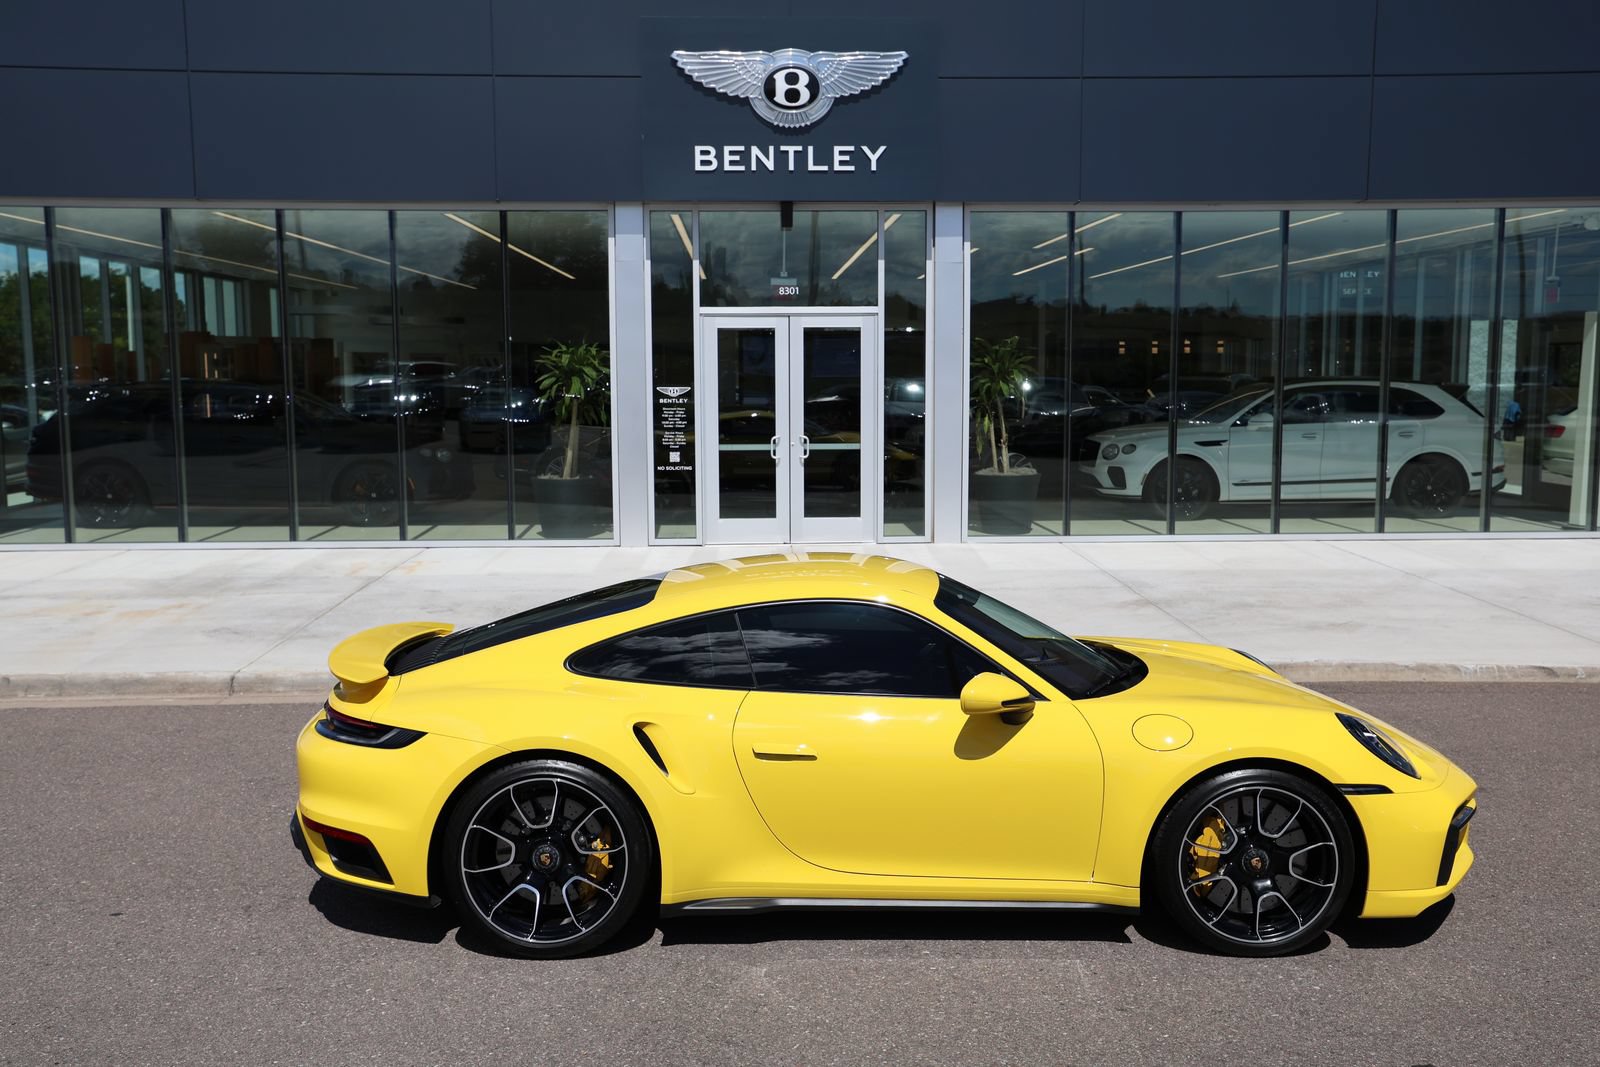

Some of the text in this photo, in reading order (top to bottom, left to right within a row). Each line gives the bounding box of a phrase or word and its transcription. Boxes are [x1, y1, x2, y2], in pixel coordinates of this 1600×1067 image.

[773, 67, 811, 107] B
[694, 145, 887, 172] BENTLEY
[778, 286, 799, 295] 8301
